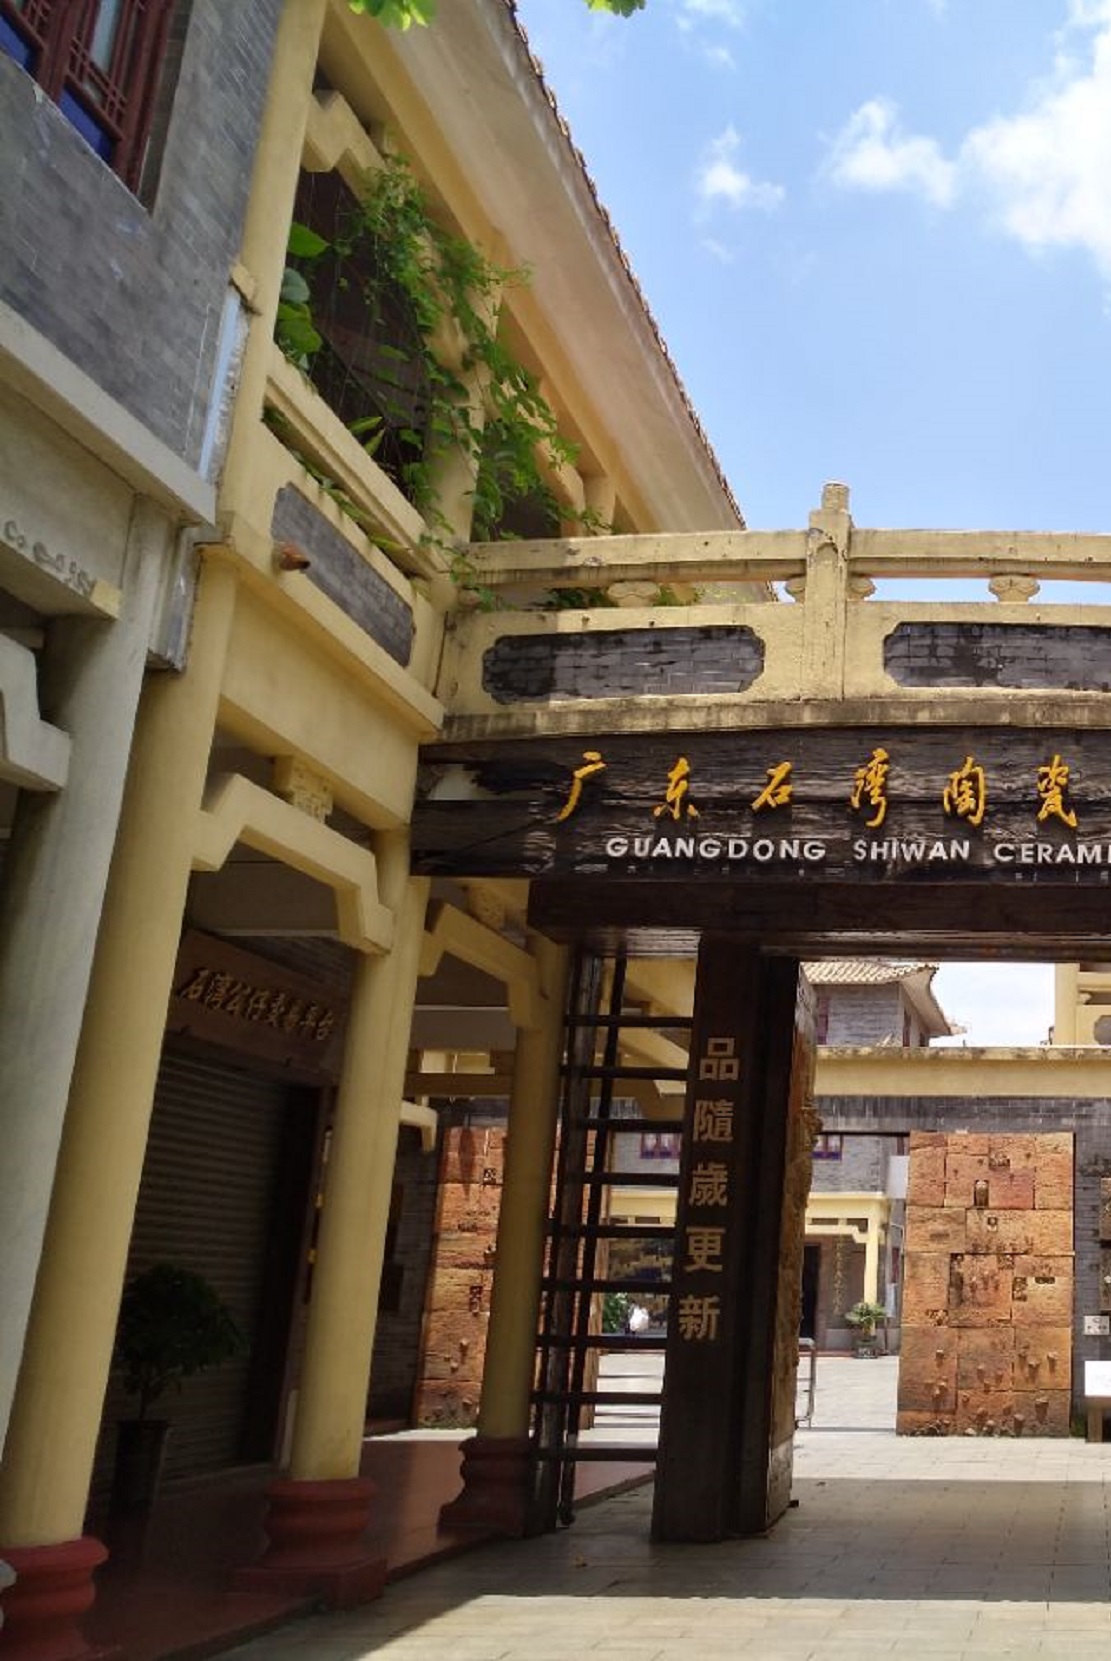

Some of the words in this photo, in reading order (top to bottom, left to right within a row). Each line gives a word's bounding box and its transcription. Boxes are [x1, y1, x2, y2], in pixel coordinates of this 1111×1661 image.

[606, 837, 826, 861] GUANGDONG
[854, 839, 971, 863] SHIWAN
[678, 1037, 740, 1340] 品隨歲更新
